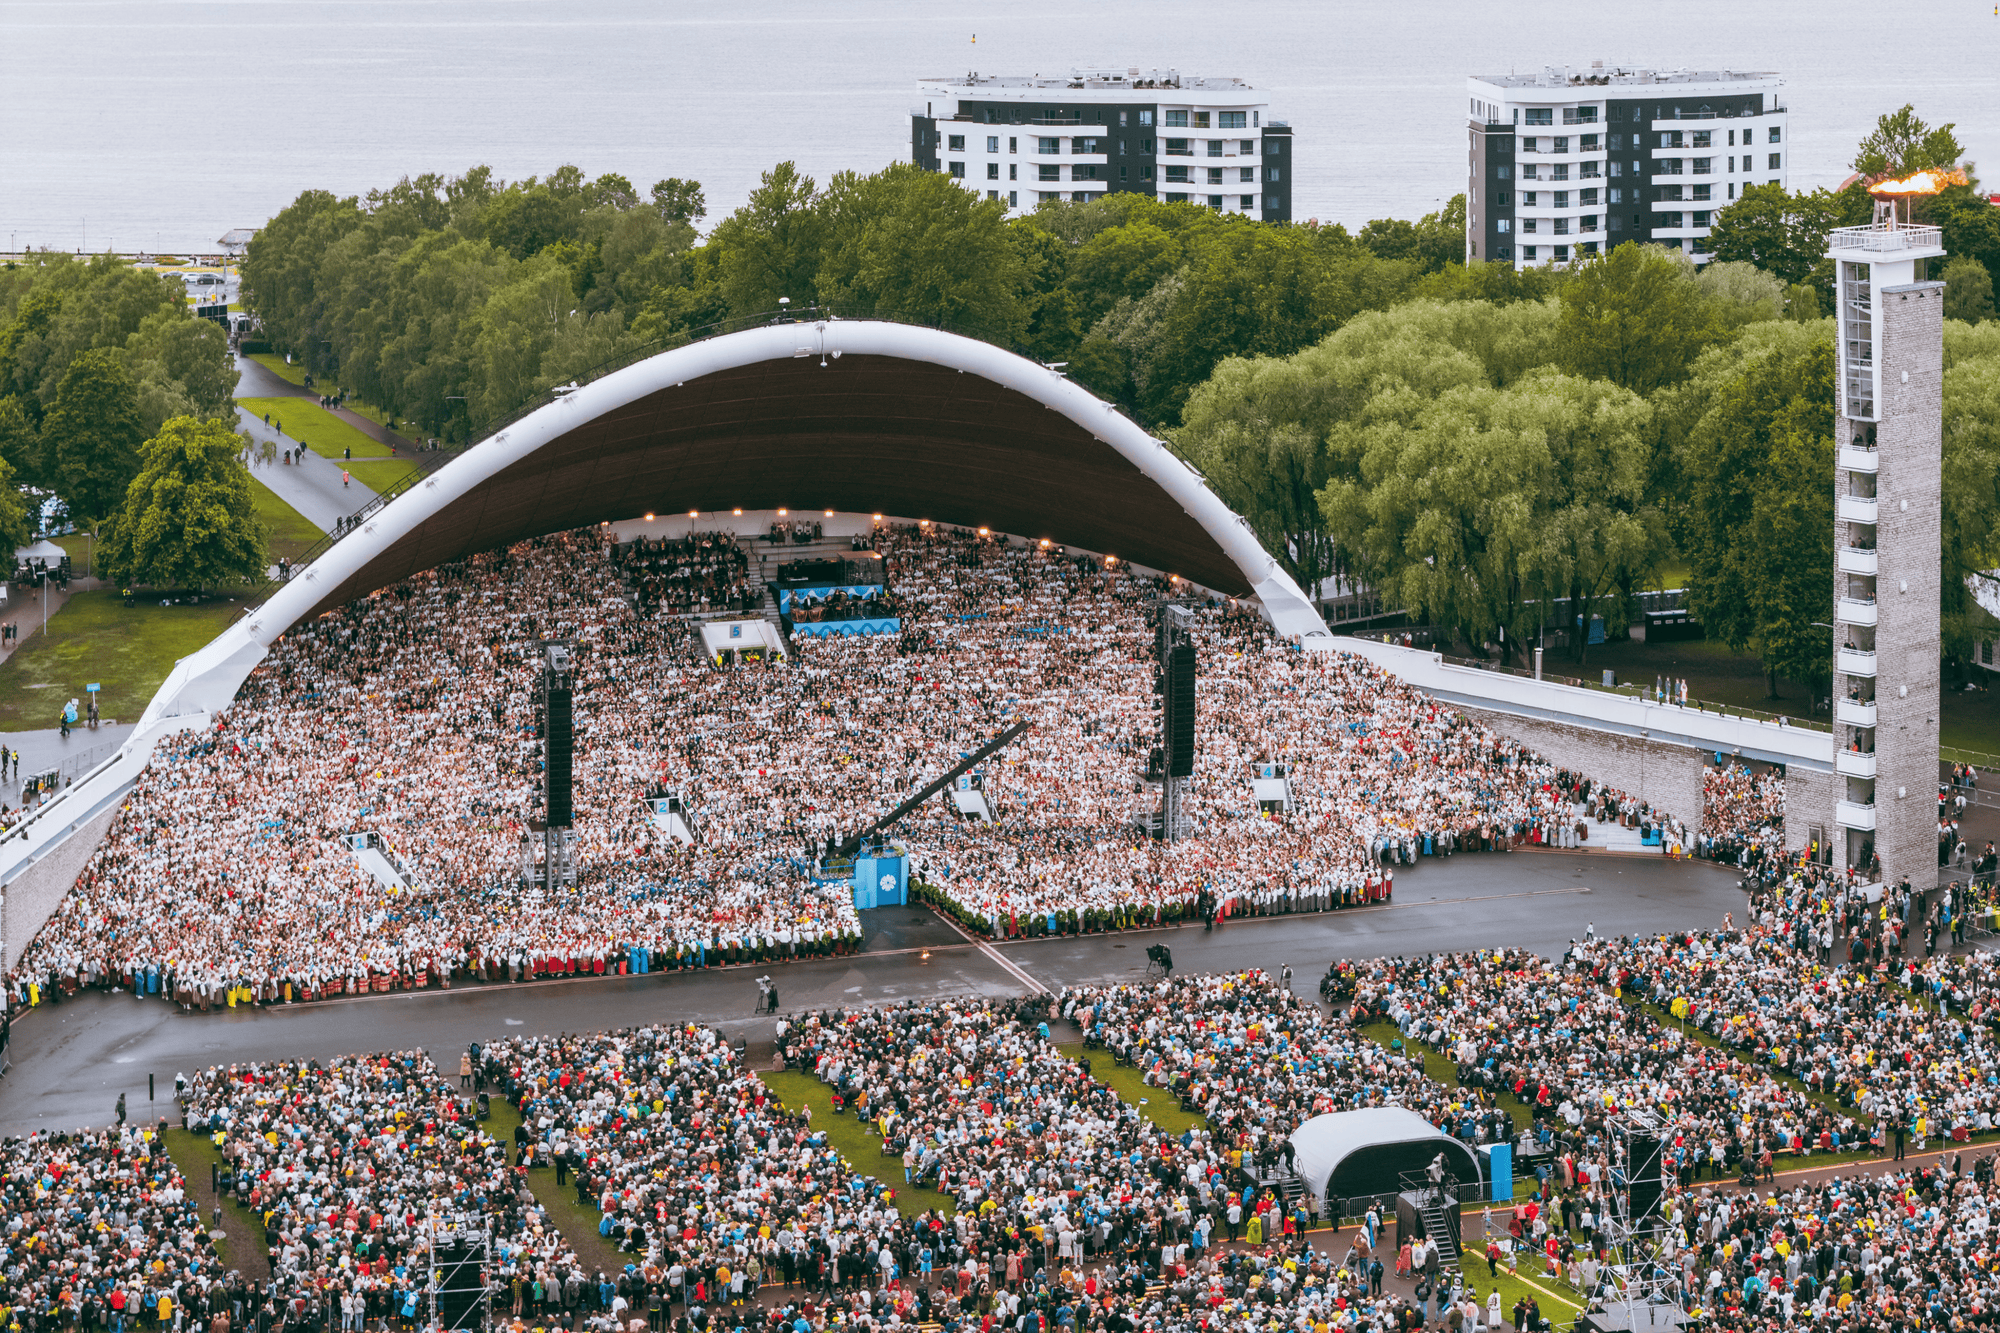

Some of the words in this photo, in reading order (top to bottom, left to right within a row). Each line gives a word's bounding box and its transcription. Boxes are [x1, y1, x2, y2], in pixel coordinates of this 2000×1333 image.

[732, 625, 740, 637] 5
[1263, 766, 1273, 778] 4
[961, 778, 969, 790] 3
[658, 801, 667, 813] 2
[355, 837, 365, 849] 1
